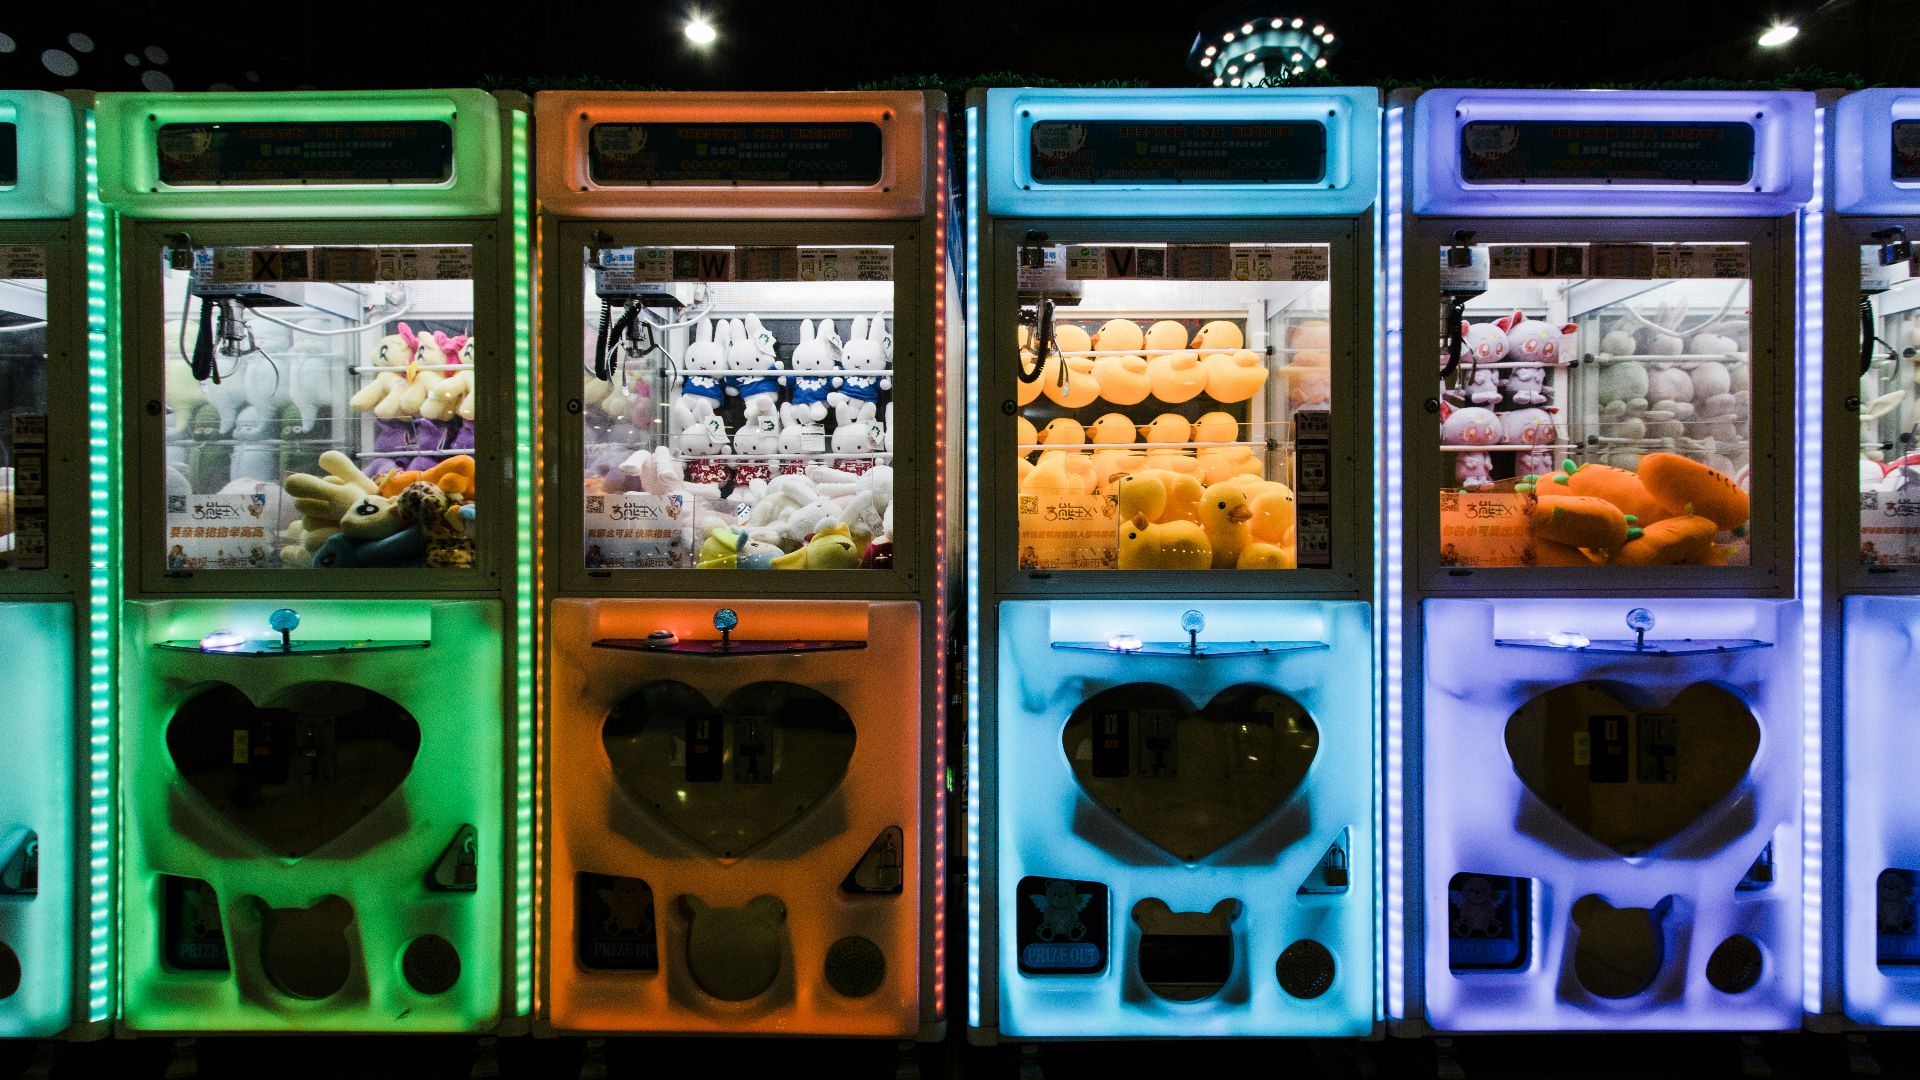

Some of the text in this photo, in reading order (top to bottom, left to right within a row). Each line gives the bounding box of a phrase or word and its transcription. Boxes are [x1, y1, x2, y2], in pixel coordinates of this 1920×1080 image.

[256, 251, 278, 280] X
[701, 254, 726, 278] W
[1110, 248, 1133, 277] V
[1529, 247, 1552, 275] U
[180, 943, 220, 959] PRIZE
[593, 941, 634, 958] PRIZE
[1028, 947, 1096, 963] PRIZE OUT
